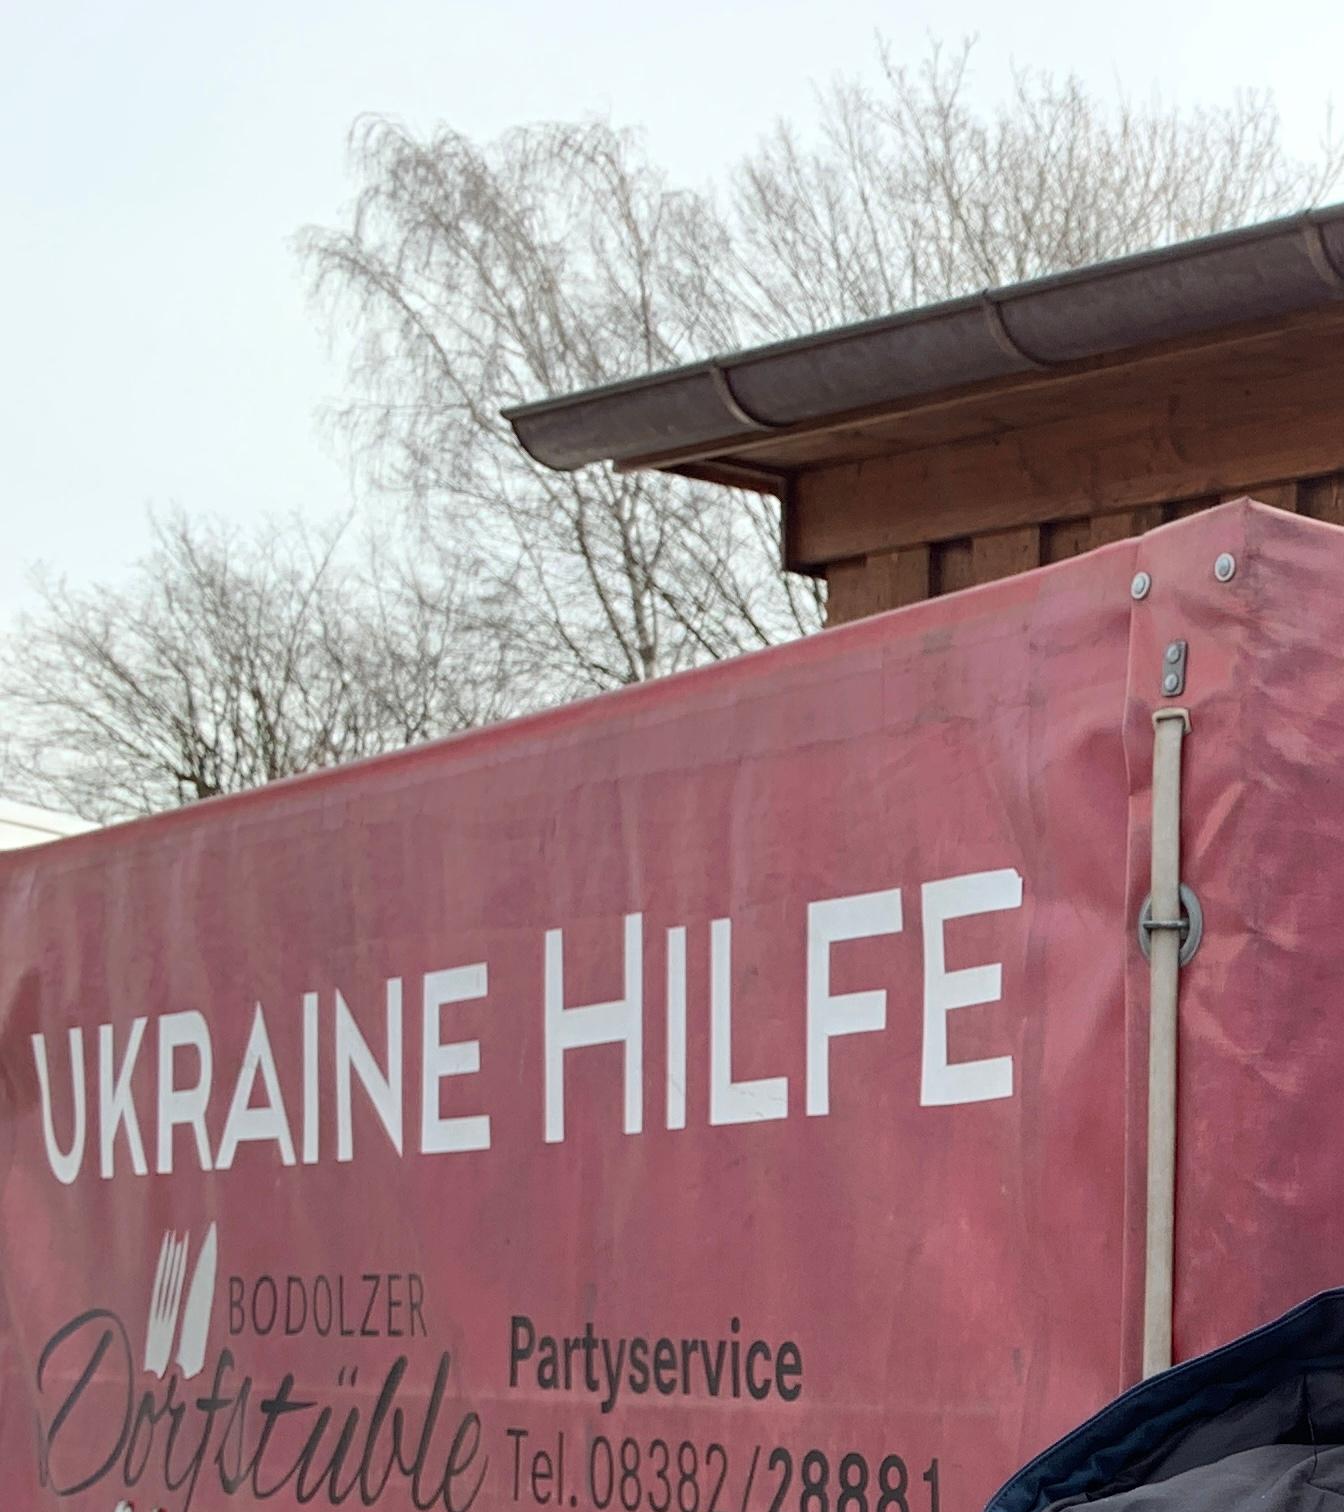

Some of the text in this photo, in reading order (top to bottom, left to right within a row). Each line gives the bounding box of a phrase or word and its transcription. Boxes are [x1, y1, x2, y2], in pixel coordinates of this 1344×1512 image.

[31, 868, 1022, 1184] UKRAINE HILFE
[228, 1274, 428, 1337] BODOLZER
[508, 1315, 803, 1413] Partyservice
